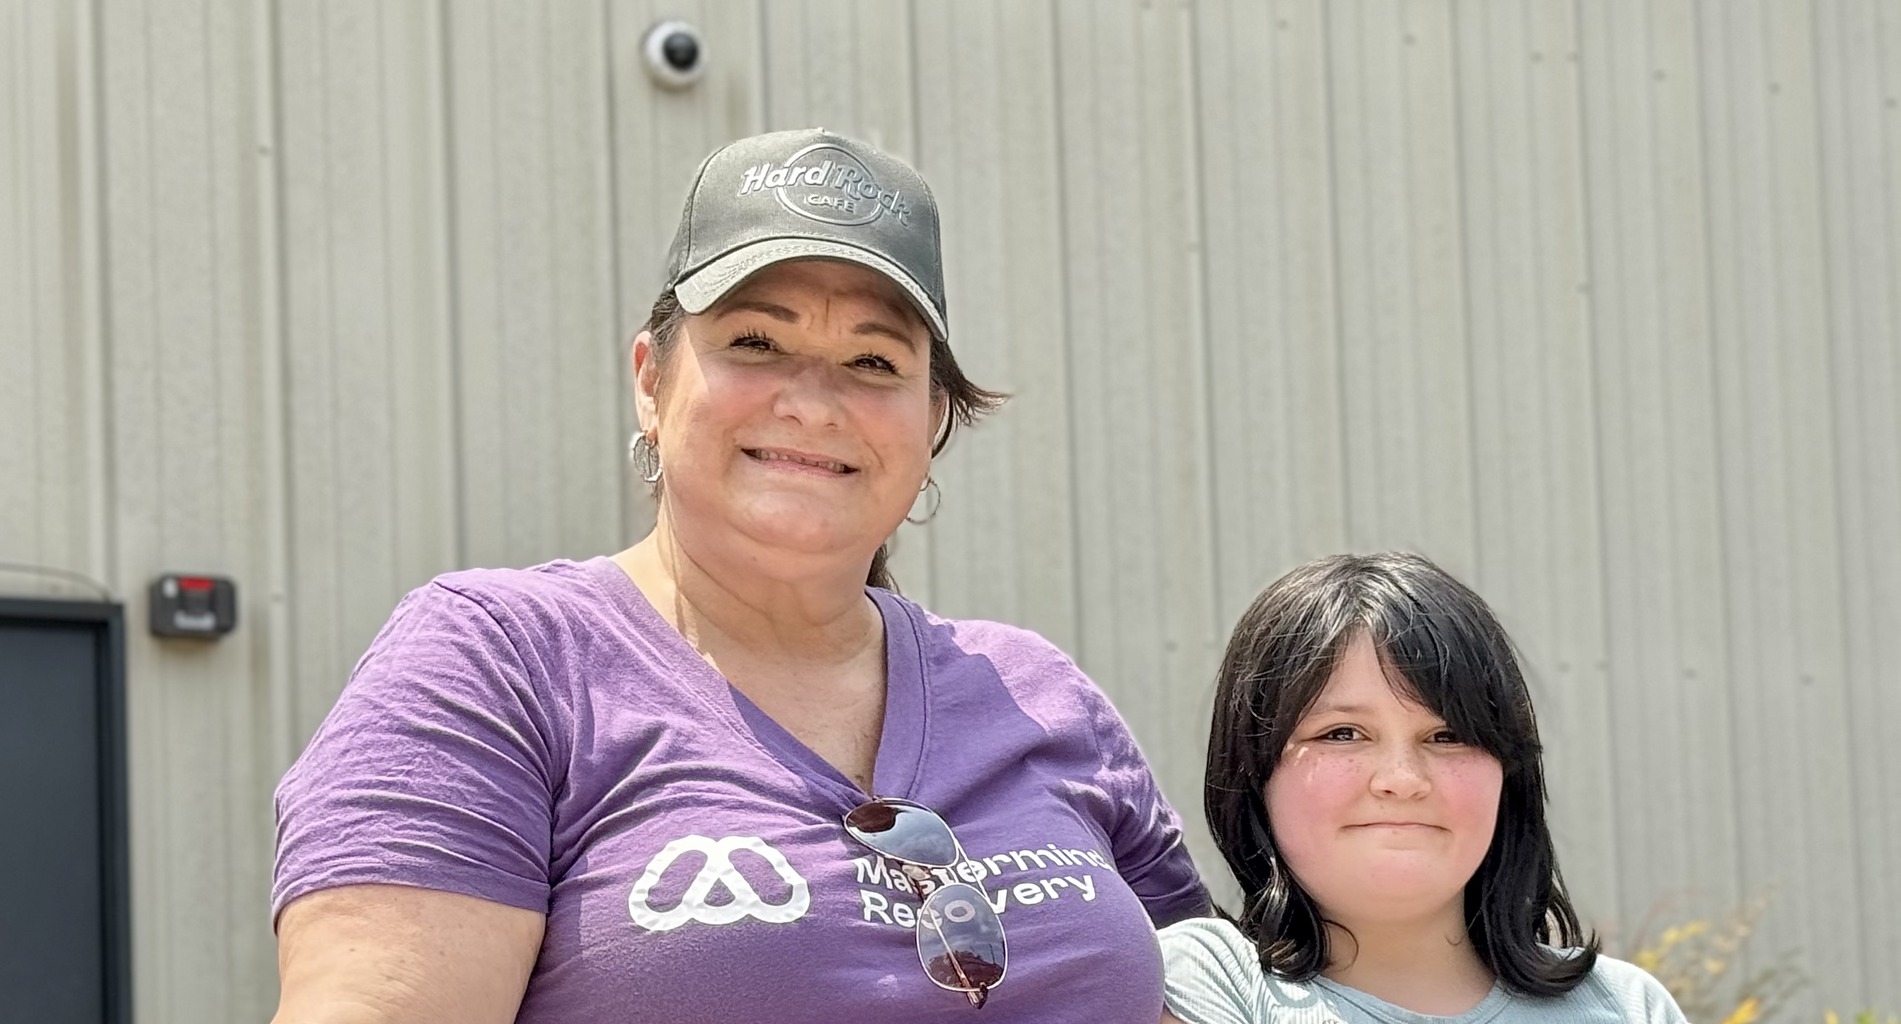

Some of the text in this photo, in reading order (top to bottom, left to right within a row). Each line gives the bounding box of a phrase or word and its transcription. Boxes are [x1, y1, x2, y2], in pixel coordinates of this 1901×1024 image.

[739, 160, 912, 227] Hard Rock
[859, 874, 1096, 930] Recovery
